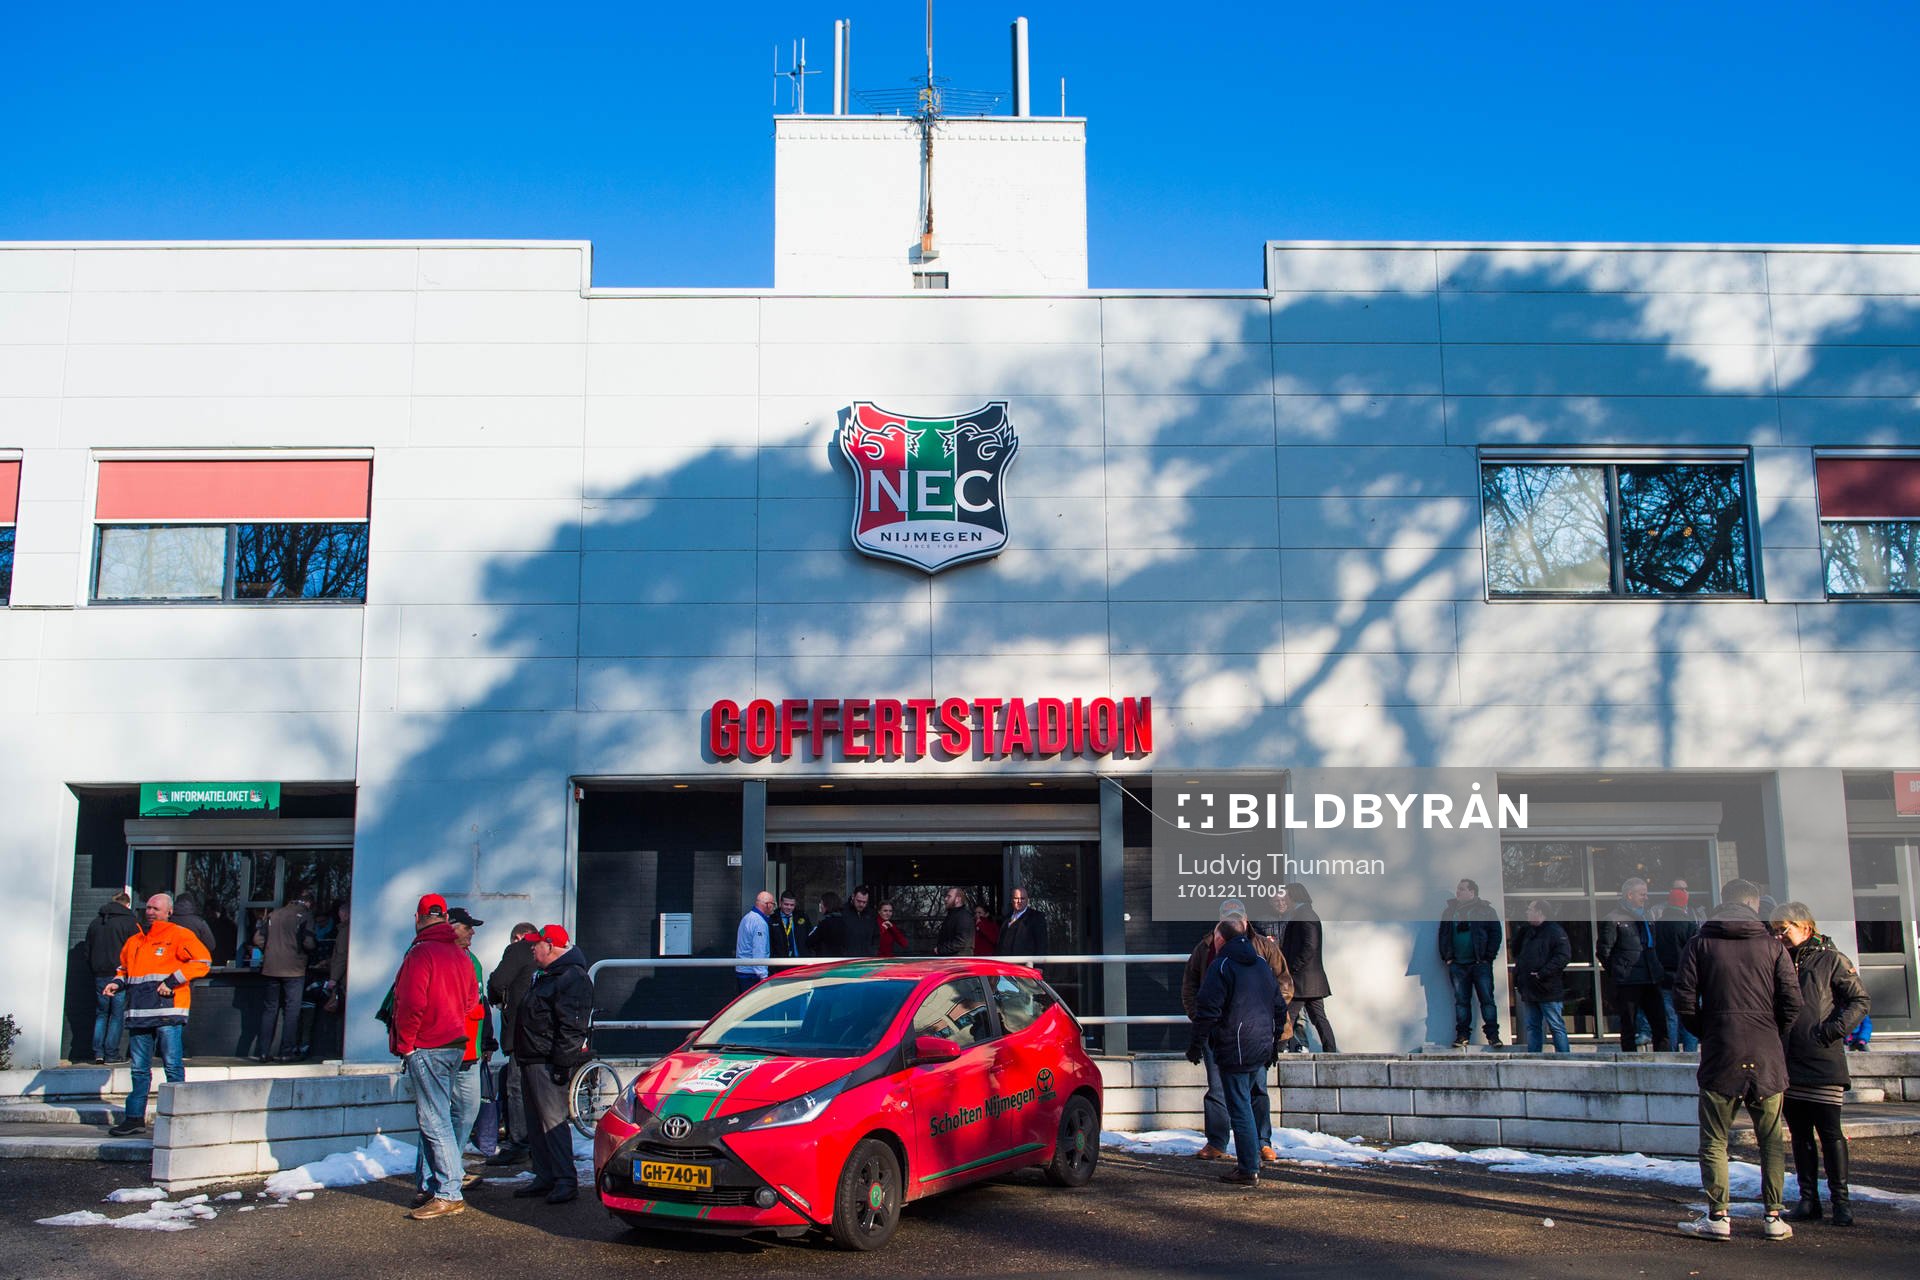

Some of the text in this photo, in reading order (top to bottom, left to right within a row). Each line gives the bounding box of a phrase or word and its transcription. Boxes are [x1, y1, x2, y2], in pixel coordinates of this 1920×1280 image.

[869, 470, 995, 512] NEC
[881, 532, 982, 541] NIJMEGEN
[710, 697, 1153, 756] GOFFERTSTADION
[171, 790, 248, 802] INFORMATIELOKET
[930, 1106, 982, 1137] Scholten
[985, 1087, 1035, 1119] Nijmegen
[643, 1164, 707, 1185] GH-740-N
